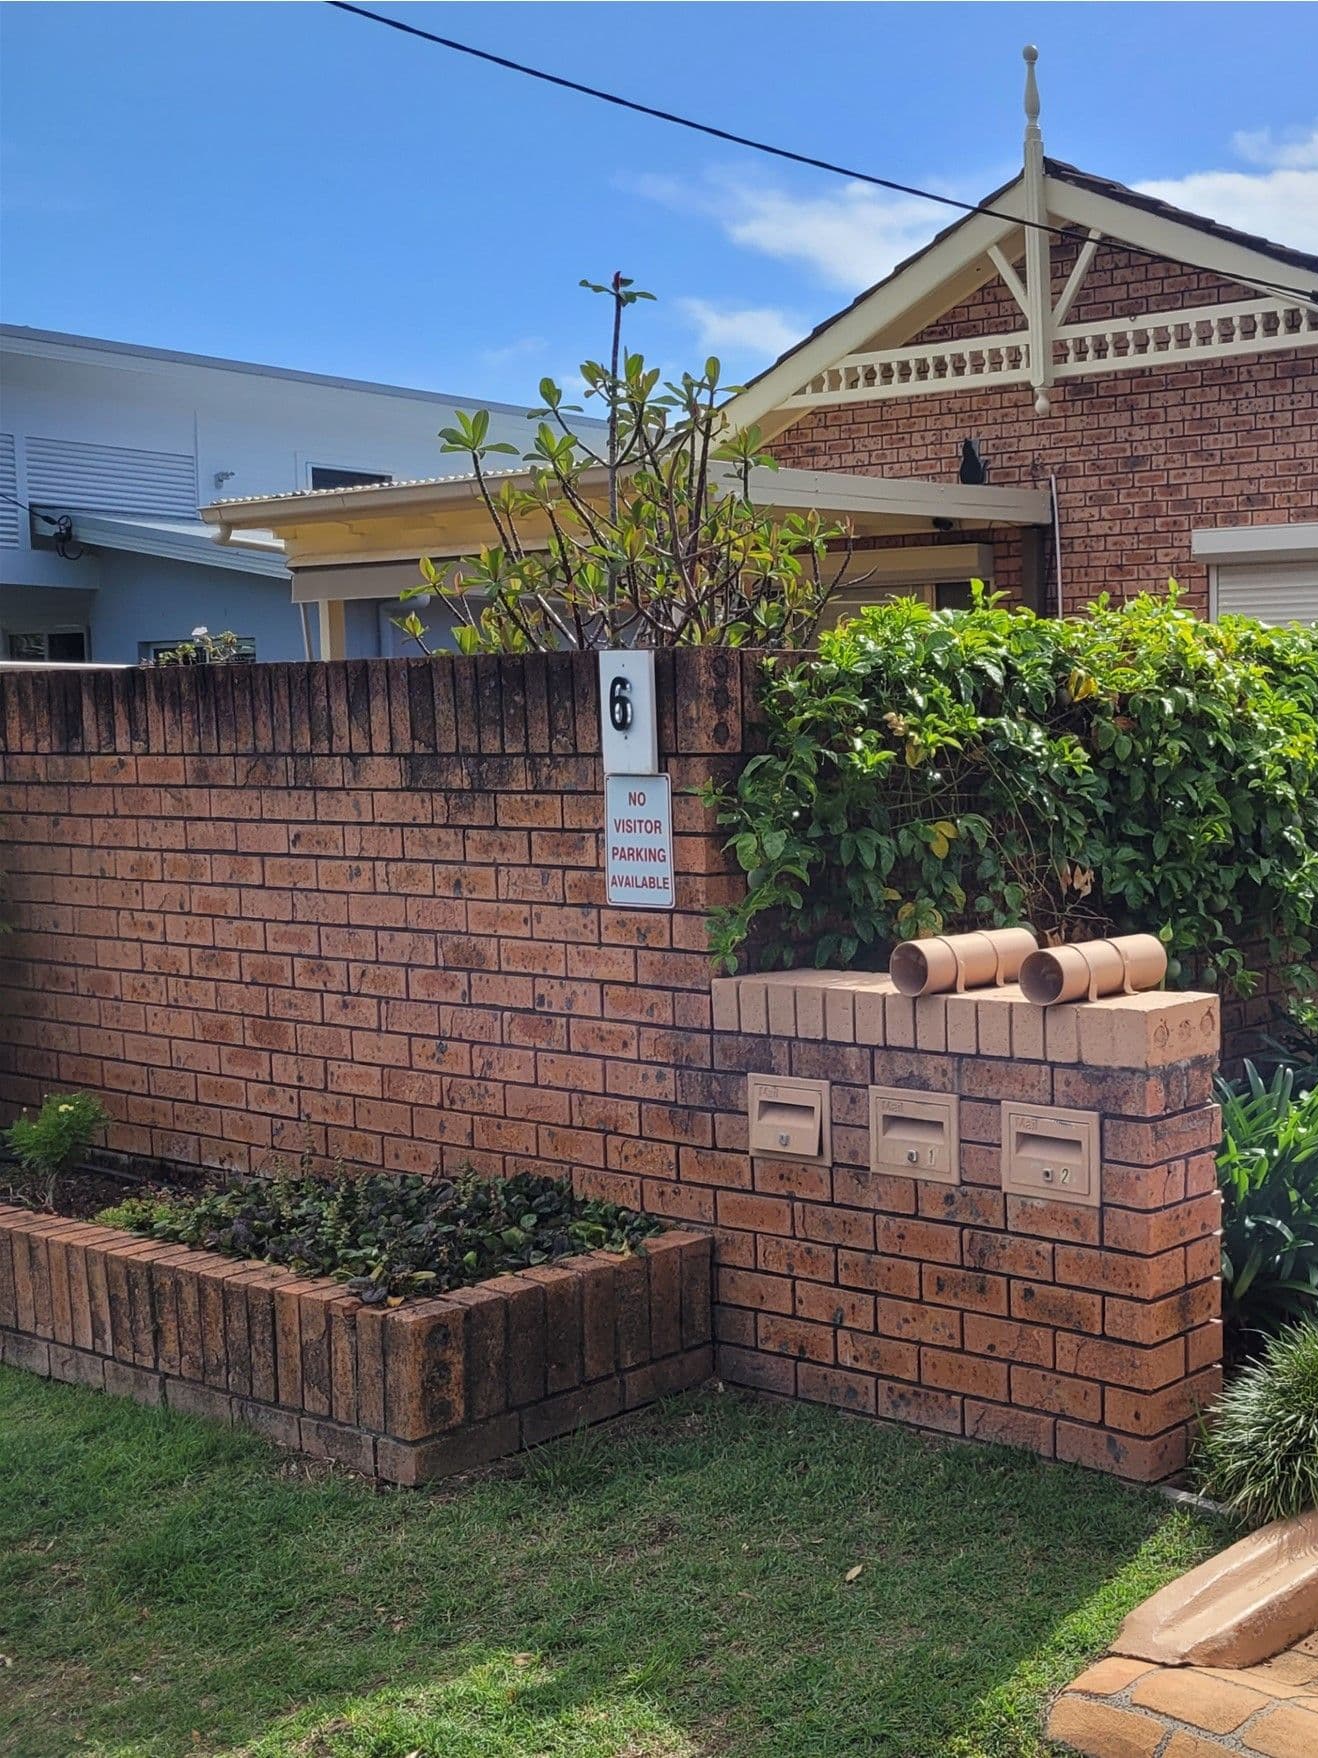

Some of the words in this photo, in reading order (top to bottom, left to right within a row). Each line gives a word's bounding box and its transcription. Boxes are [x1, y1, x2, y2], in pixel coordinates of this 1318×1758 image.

[610, 676, 632, 731] 6
[628, 791, 646, 807] NO
[614, 819, 662, 835] VISITOR
[612, 846, 667, 864] PARKING
[610, 875, 670, 890] AVAILABLE
[1015, 1116, 1038, 1131] Mail
[1061, 1168, 1069, 1184] 2
